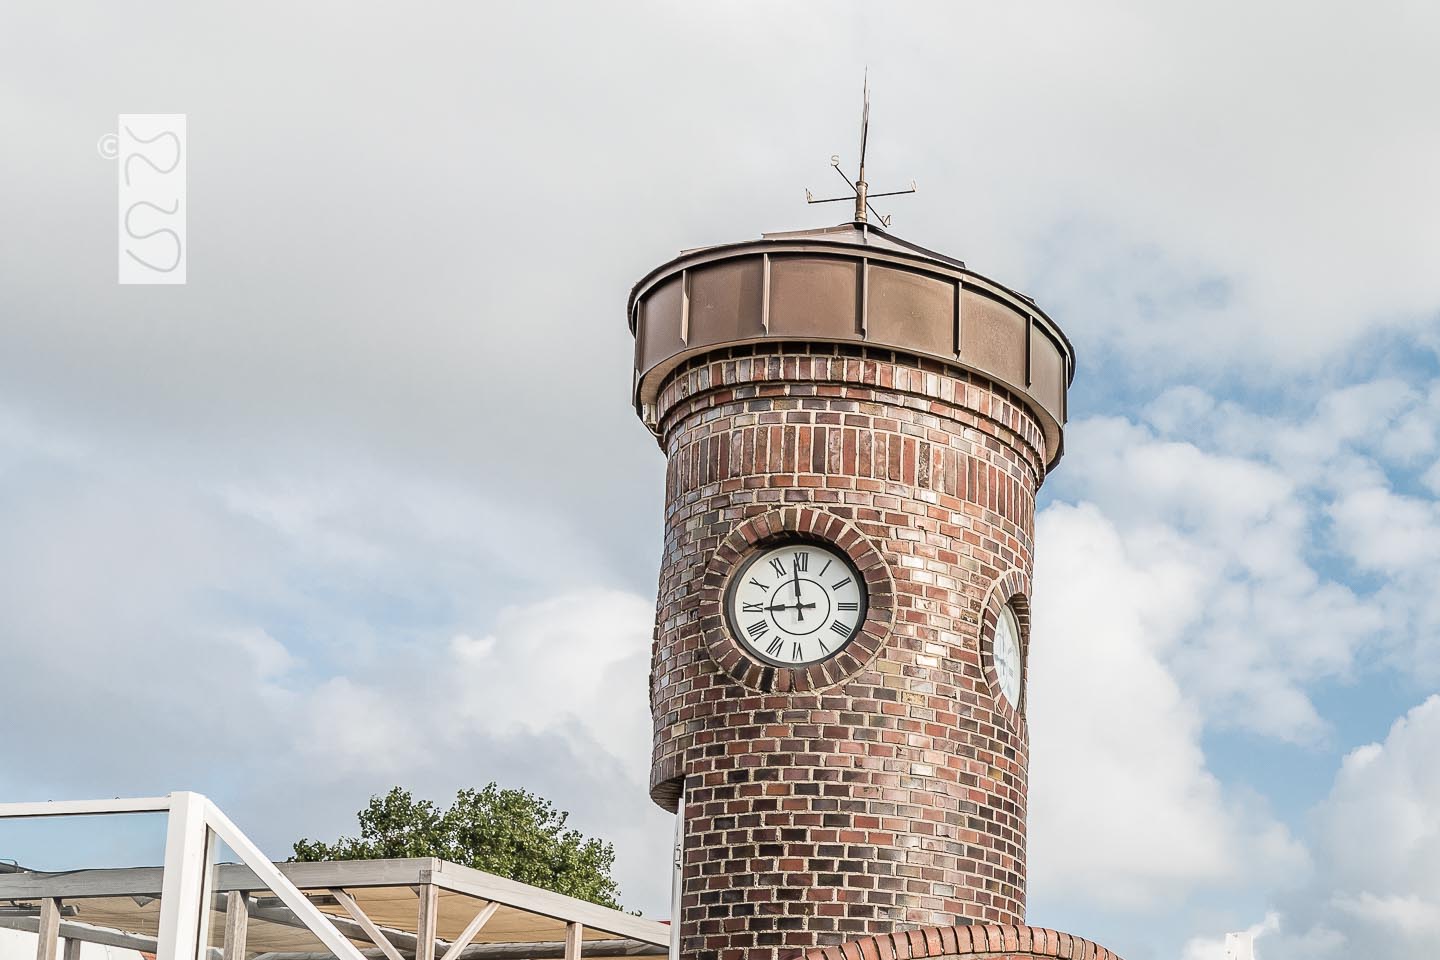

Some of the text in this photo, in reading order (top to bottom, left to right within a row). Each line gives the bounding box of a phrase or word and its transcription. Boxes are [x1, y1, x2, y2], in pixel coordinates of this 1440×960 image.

[794, 552, 809, 572] XII
[832, 577, 852, 591] II
[838, 602, 858, 611] III
